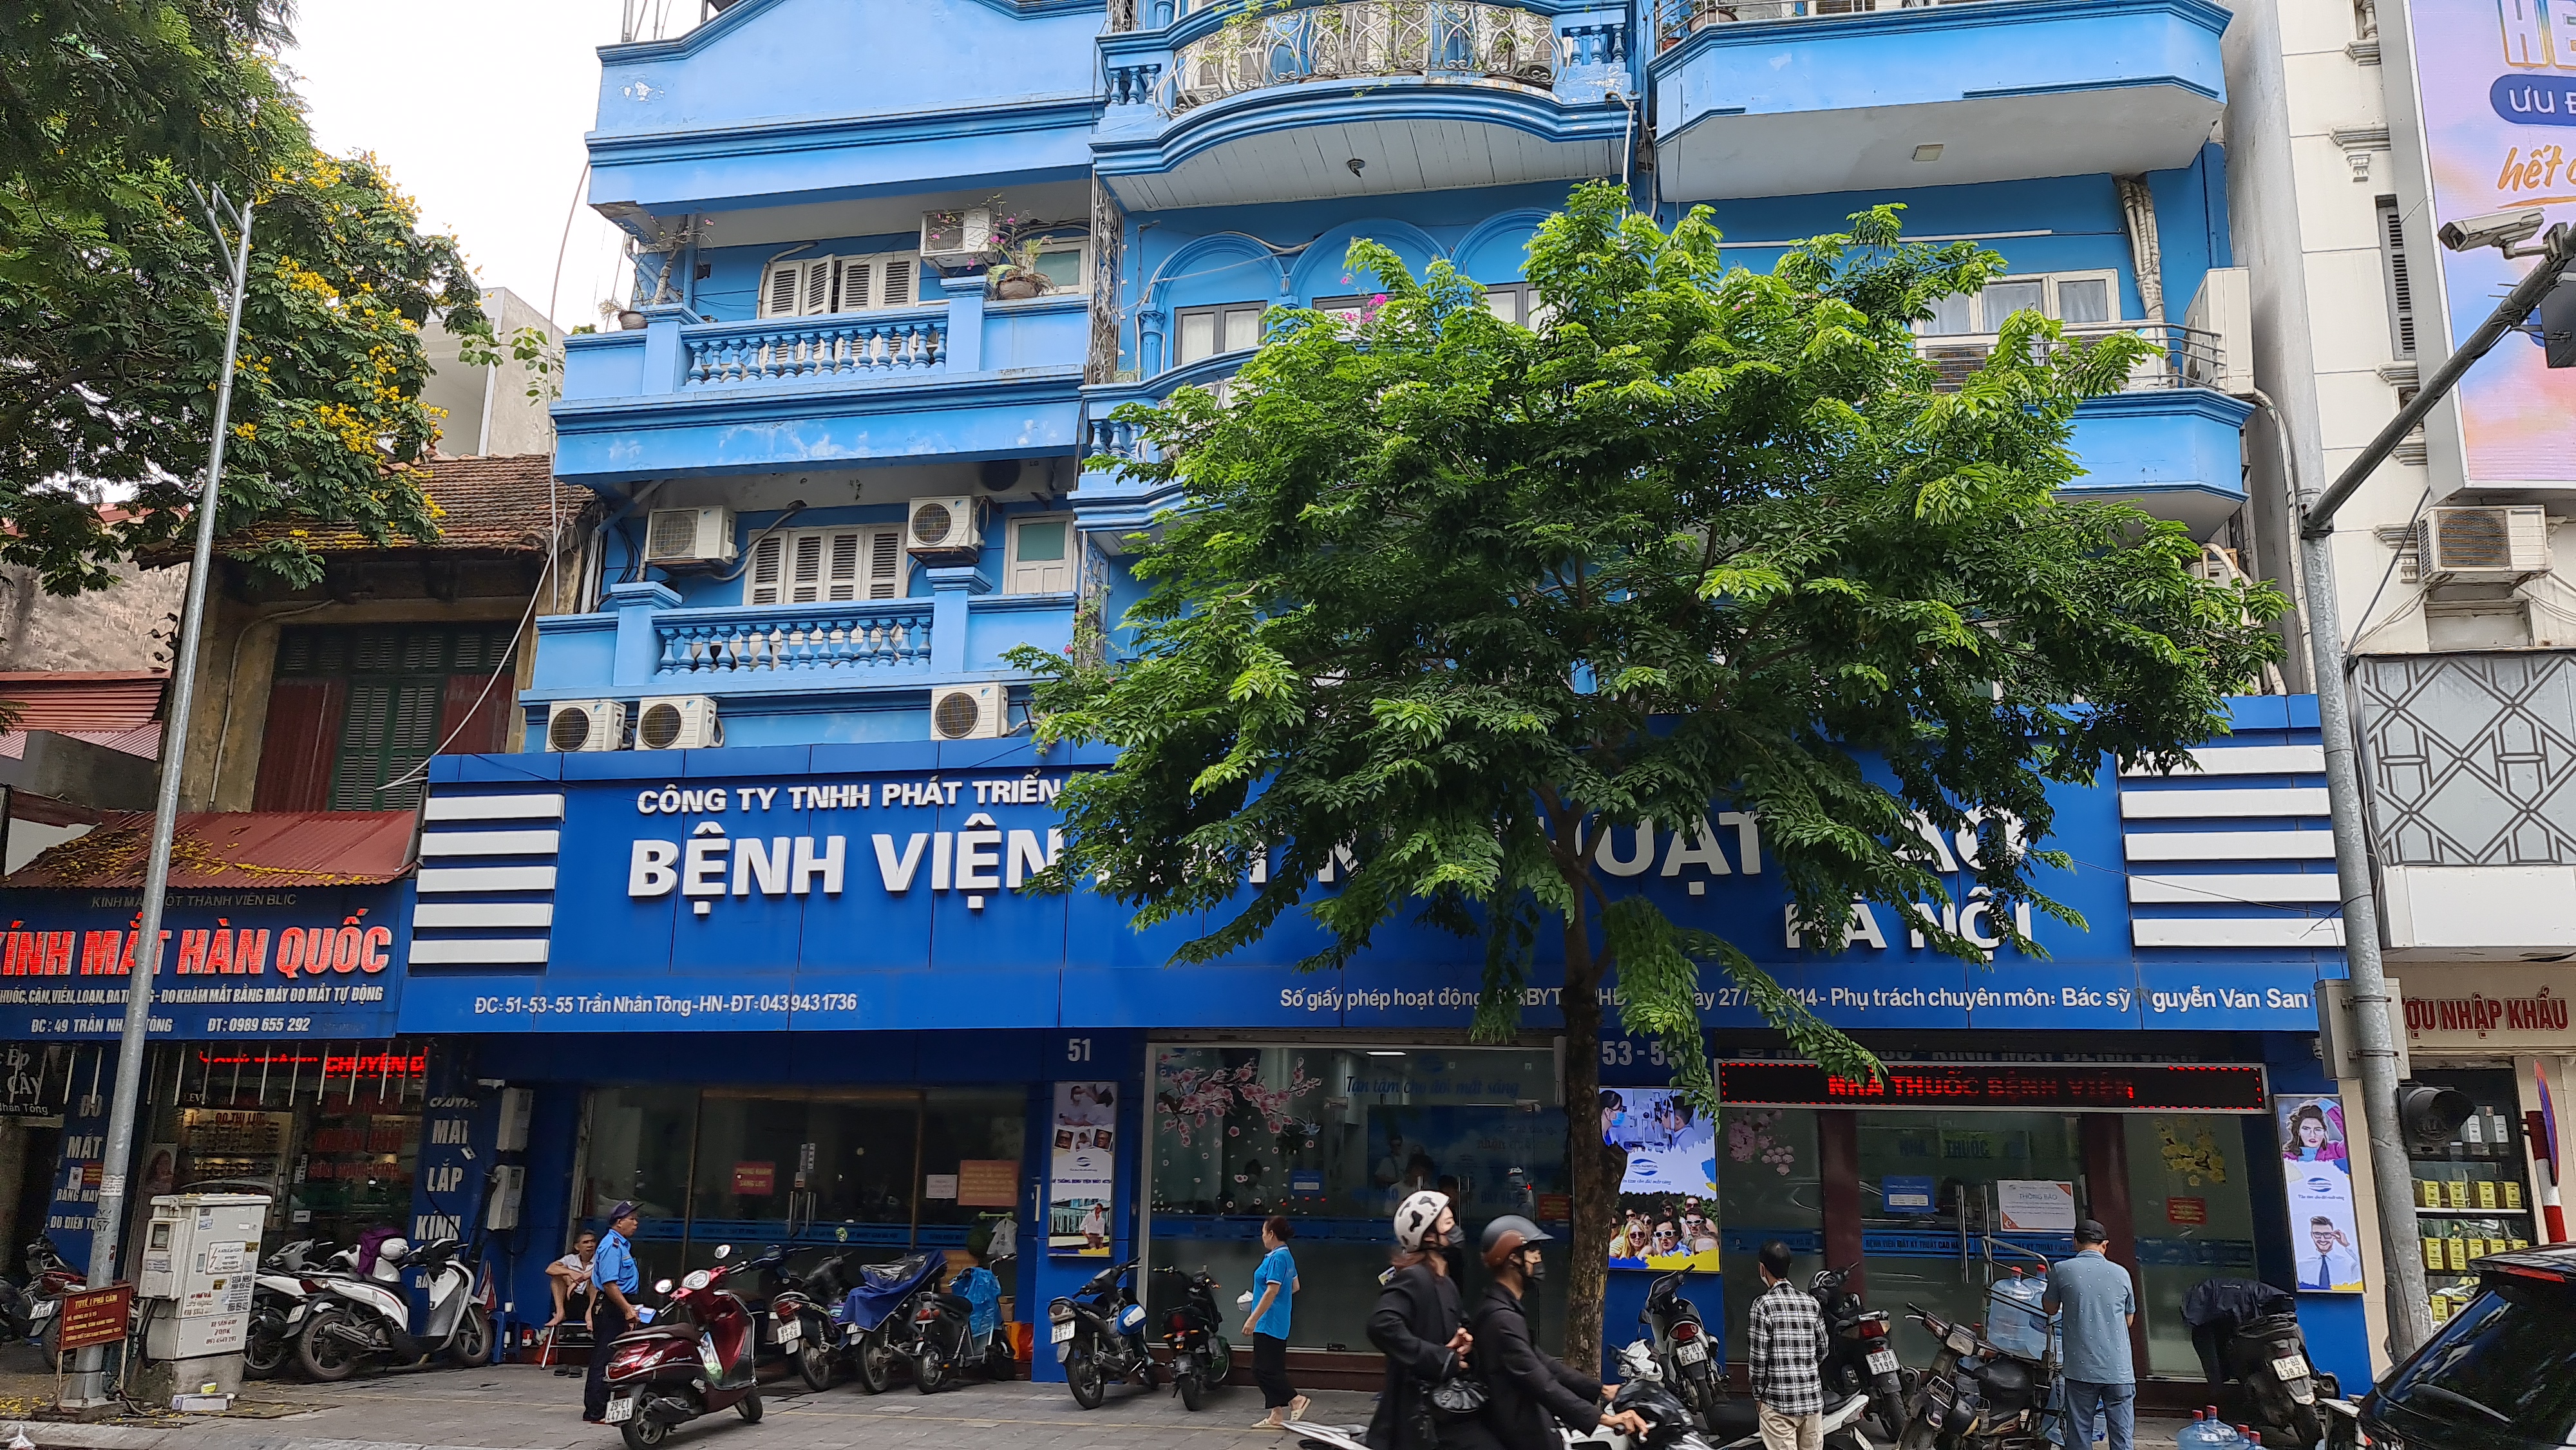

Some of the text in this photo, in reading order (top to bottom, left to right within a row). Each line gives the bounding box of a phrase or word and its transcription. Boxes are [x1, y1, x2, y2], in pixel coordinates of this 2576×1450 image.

[2508, 85, 2555, 114] ƯU
[2497, 145, 2563, 192] hết
[638, 768, 1061, 814] CÔNG TY TNHH PHÁT TRIỂN
[628, 821, 846, 916] BỆNH
[871, 813, 1065, 910] VIỆN
[187, 893, 232, 907] THÀNH
[176, 918, 270, 974] HÀN
[276, 908, 392, 979] QUỐC
[334, 985, 350, 1005] TỰ
[578, 992, 611, 1013] Trần
[614, 995, 652, 1013] Nhân
[1280, 986, 1304, 1008] Số
[1307, 986, 1343, 1012] giấy
[1347, 988, 1390, 1010] phép
[1394, 988, 1435, 1010] hoạt
[1831, 988, 1869, 1012] Phụ
[1873, 987, 1924, 1006] trách
[1927, 988, 2005, 1012] chuyên
[2062, 987, 2102, 1007] Bác
[2106, 988, 2131, 1012] sỹ
[53, 1019, 69, 1033] 49
[73, 1012, 106, 1032] TRẦN
[229, 1017, 259, 1031] 0989
[261, 1017, 285, 1031] 655
[287, 1017, 311, 1031] 292
[2440, 993, 2503, 1038] NHẬP
[2507, 986, 2568, 1030] KHẨU
[1066, 1037, 1091, 1063] 51
[1889, 1069, 1980, 1098] THUỐC
[431, 1115, 468, 1144] MÀI
[426, 1158, 464, 1192] LẮP
[415, 1209, 461, 1241] KÍNH
